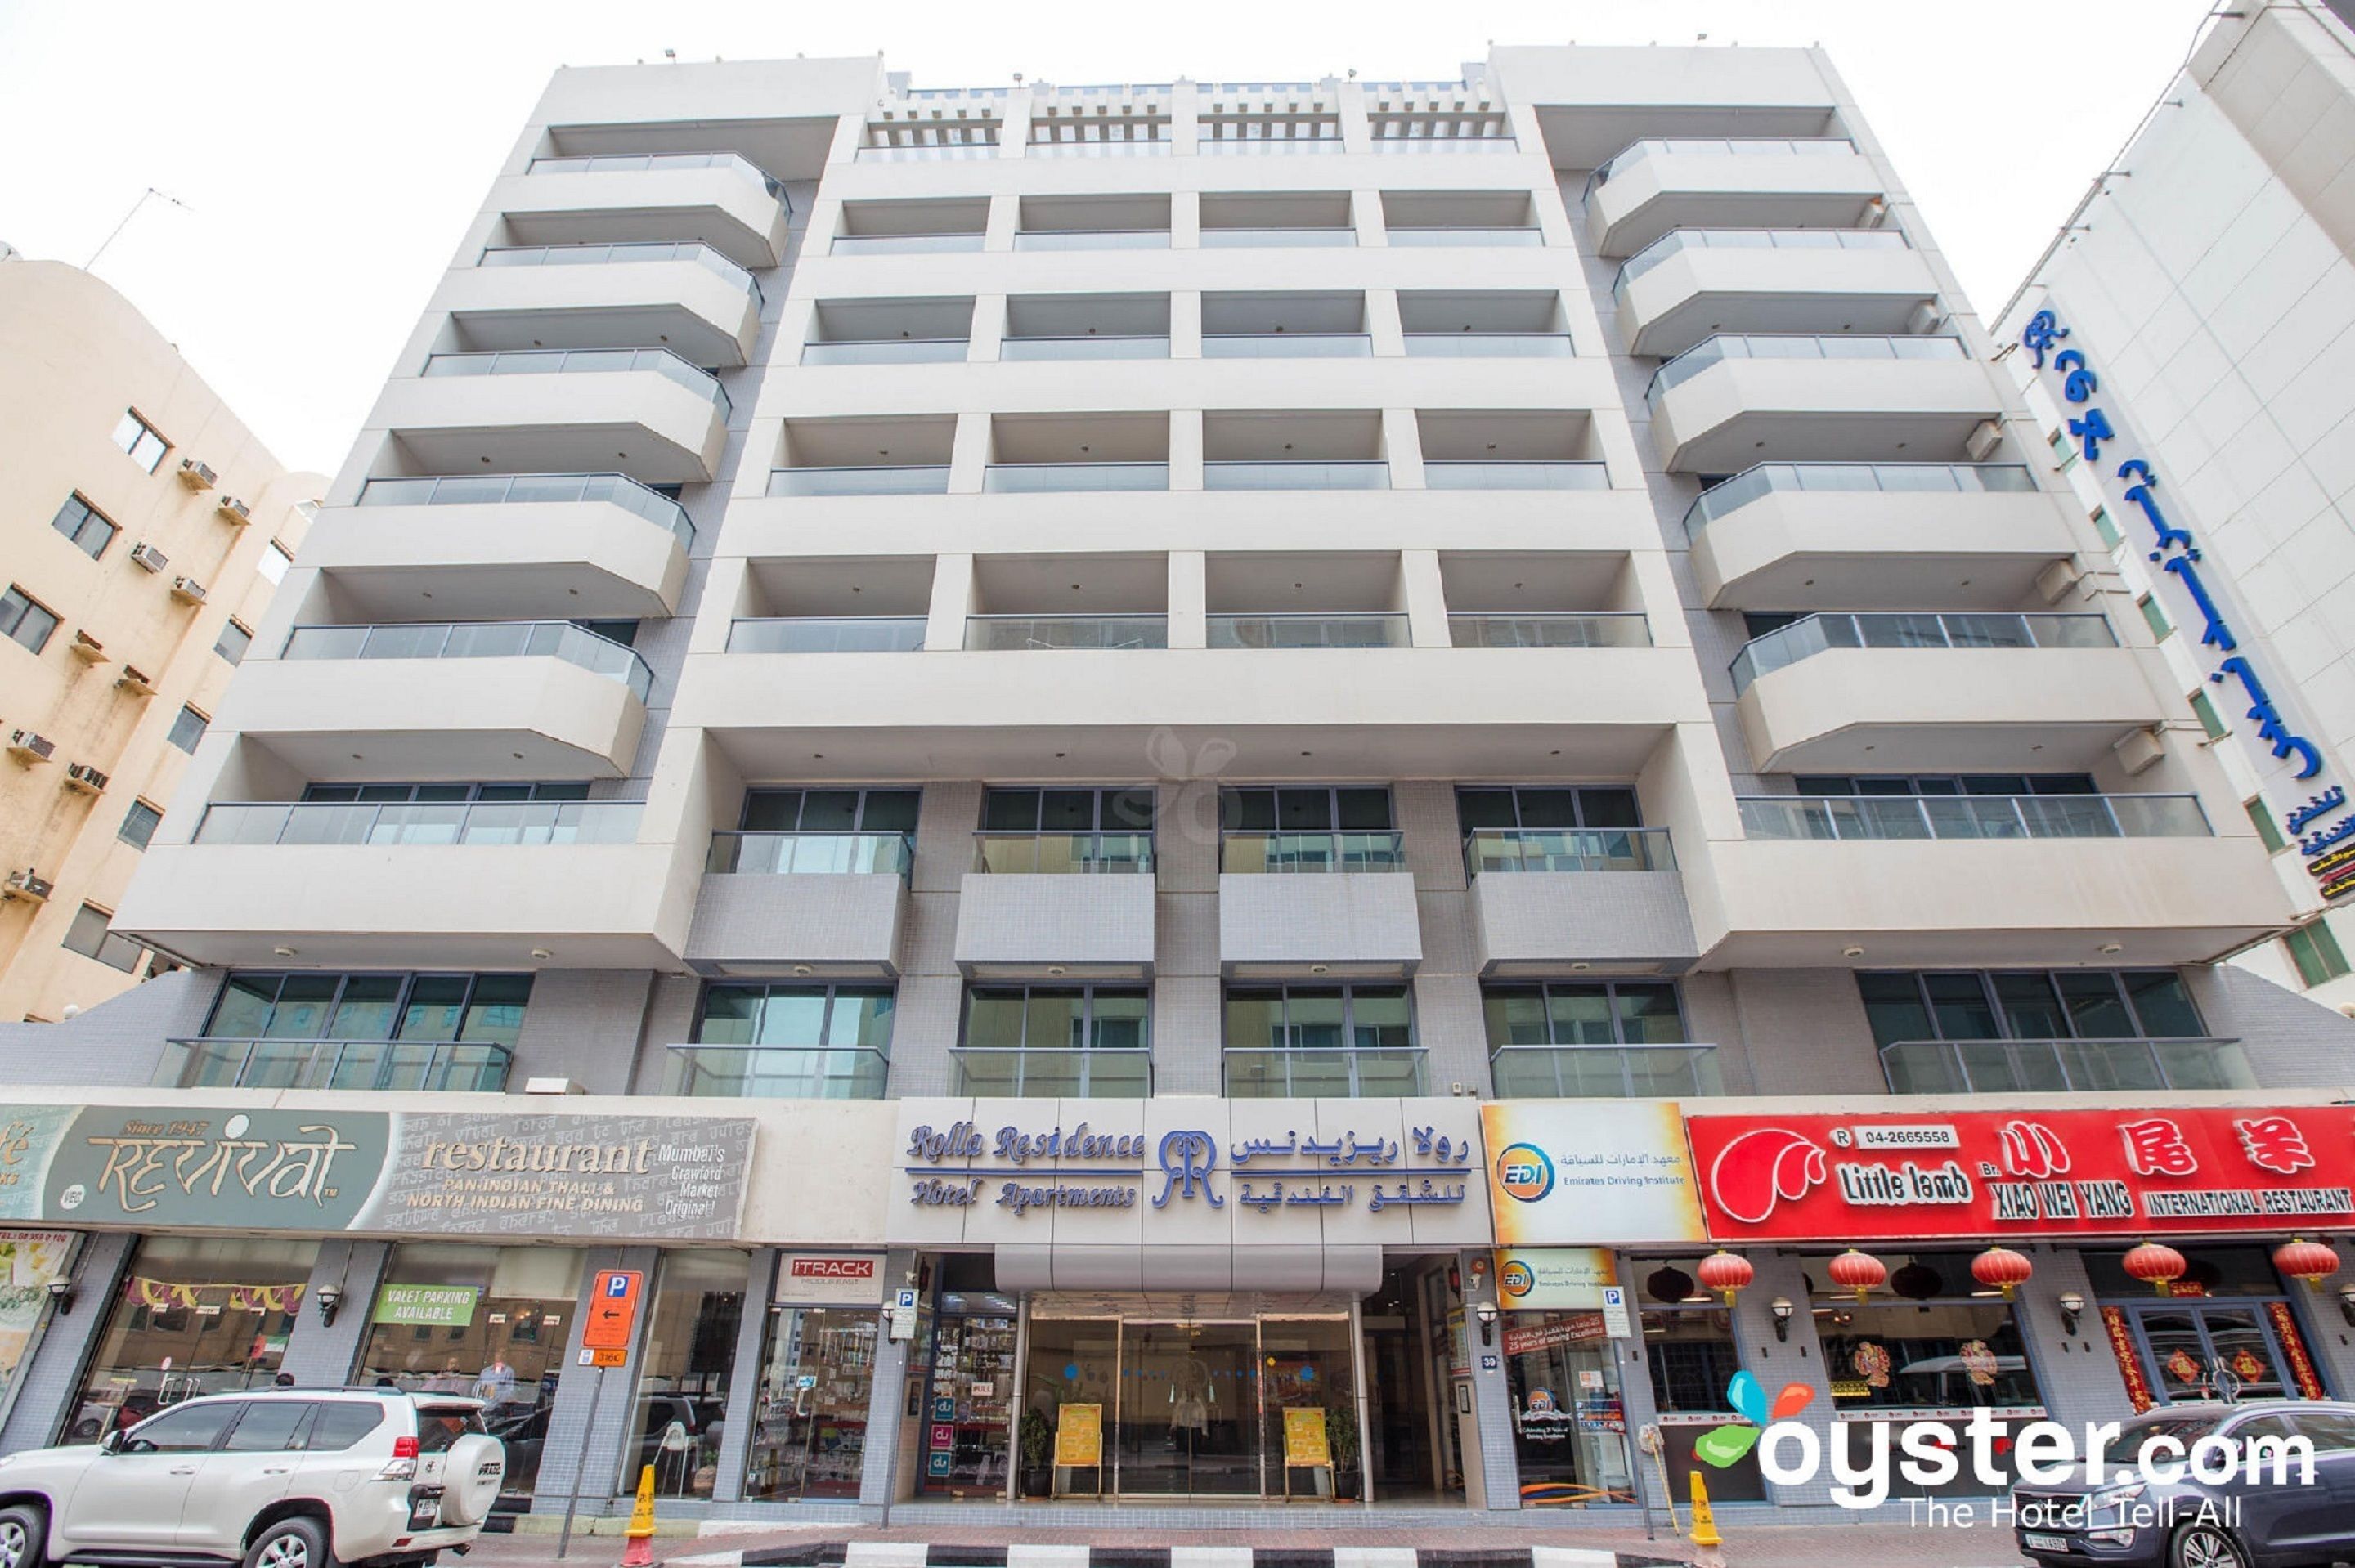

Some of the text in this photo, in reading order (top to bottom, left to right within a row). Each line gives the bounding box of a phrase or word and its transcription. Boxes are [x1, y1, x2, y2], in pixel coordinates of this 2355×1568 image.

[123, 1120, 210, 1136] Since 1947
[906, 1121, 1146, 1165] Rolla Residence
[1231, 1125, 1469, 1165] رولا ريزيدنس
[1865, 1131, 1949, 1144] 04-2665558
[420, 1134, 654, 1174] restaurant
[657, 1144, 726, 1163] Mumbai's
[1653, 1154, 1680, 1167] معهد
[671, 1165, 722, 1180] Crawford
[1505, 1163, 1543, 1185] EDI
[442, 1178, 543, 1194] PAN-INDIAN
[603, 1182, 615, 1195] &
[1563, 1176, 1685, 1187] Emirates Driving Institute
[1840, 1164, 1971, 1200] Little lamb
[680, 1183, 719, 1198] Market
[910, 1177, 1136, 1216] Hotel Apartments
[1240, 1178, 1466, 1214] للشقق الفندقية
[406, 1194, 466, 1208] NORTH
[470, 1194, 531, 1210] INDIAN
[536, 1195, 575, 1211] FINE
[581, 1197, 644, 1212] DINING
[1992, 1181, 2353, 1218] XIAO WEI YANG INTERNATIONAL RESTAURANT
[794, 1261, 871, 1275] iTRACK
[608, 1276, 626, 1297] P
[1505, 1273, 1527, 1286] EDI
[388, 1290, 471, 1304] VALET PARKING
[902, 1293, 913, 1306] P
[1607, 1291, 1618, 1303] P
[394, 1307, 454, 1320] AVAILABLE
[1509, 1341, 1519, 1351] 25
[1520, 1339, 1537, 1350] years
[1571, 1326, 1604, 1339] Excellence
